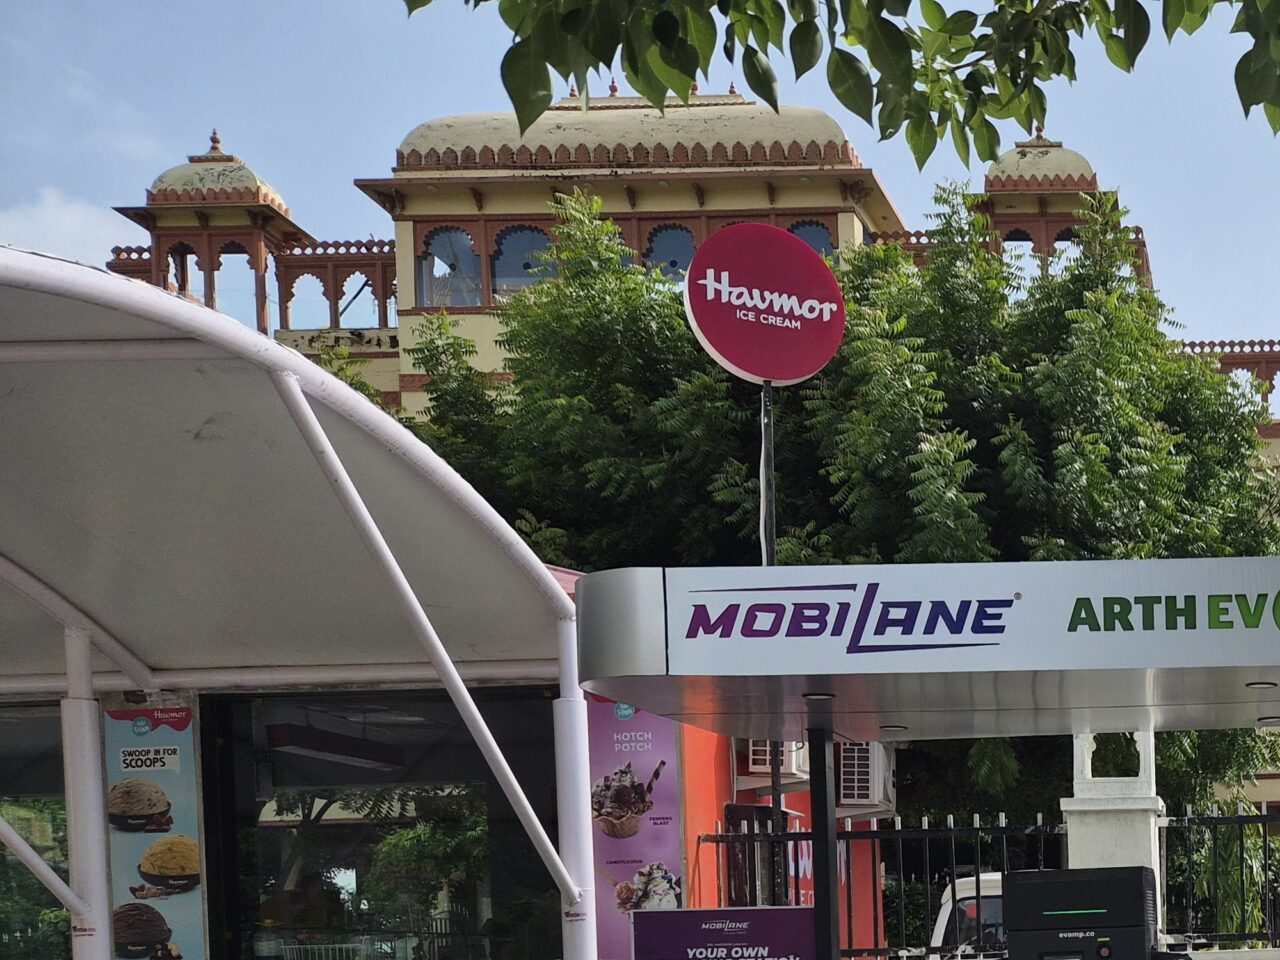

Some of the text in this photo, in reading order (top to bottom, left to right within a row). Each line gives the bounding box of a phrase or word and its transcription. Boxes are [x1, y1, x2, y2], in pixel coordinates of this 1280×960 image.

[696, 268, 837, 322] Havmor
[736, 309, 801, 330] ICE CREAM
[685, 583, 1014, 654] MOBILANE
[614, 731, 652, 742] HOTCH
[615, 742, 652, 751] POTCH
[122, 749, 151, 758] SWOOP
[163, 748, 178, 756] FOR
[123, 757, 166, 769] SCOOPS
[1058, 931, 1095, 939] evamp.co
[687, 947, 769, 959] YOUR OWN
